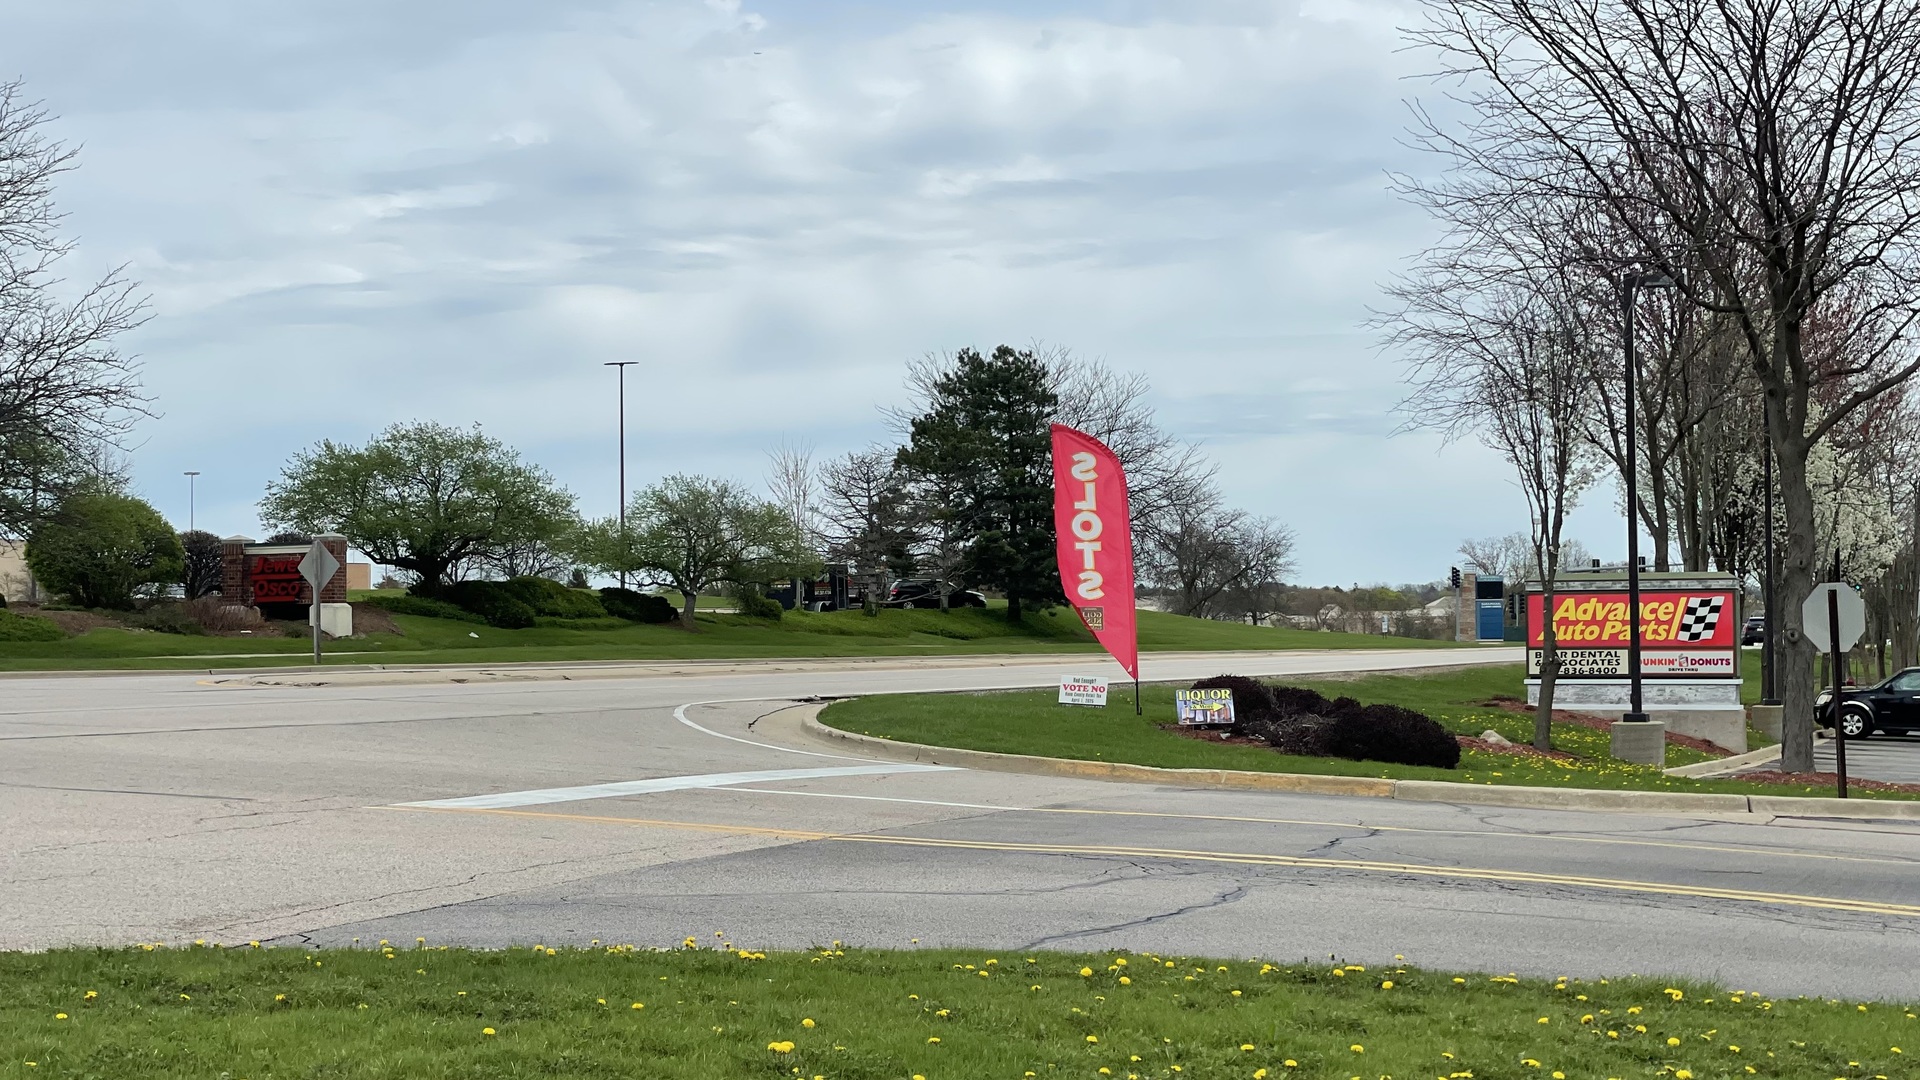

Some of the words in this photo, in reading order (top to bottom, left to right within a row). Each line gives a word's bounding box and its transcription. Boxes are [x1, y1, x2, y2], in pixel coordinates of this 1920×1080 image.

[251, 556, 301, 574] Jewe
[254, 580, 300, 596] Osco
[1553, 598, 1674, 621] Advance
[1601, 621, 1669, 641] Parts
[1535, 651, 1568, 659] BR
[1571, 651, 1620, 659] DENTAL
[1561, 659, 1620, 667] SOCIATES
[1640, 658, 1678, 667] UNKIN'
[1690, 658, 1731, 667] DONUTS
[1553, 667, 1618, 675] -836-8400
[1063, 684, 1089, 692] VOTE
[1091, 685, 1106, 693] NO
[1178, 689, 1231, 701] LIQUOR
